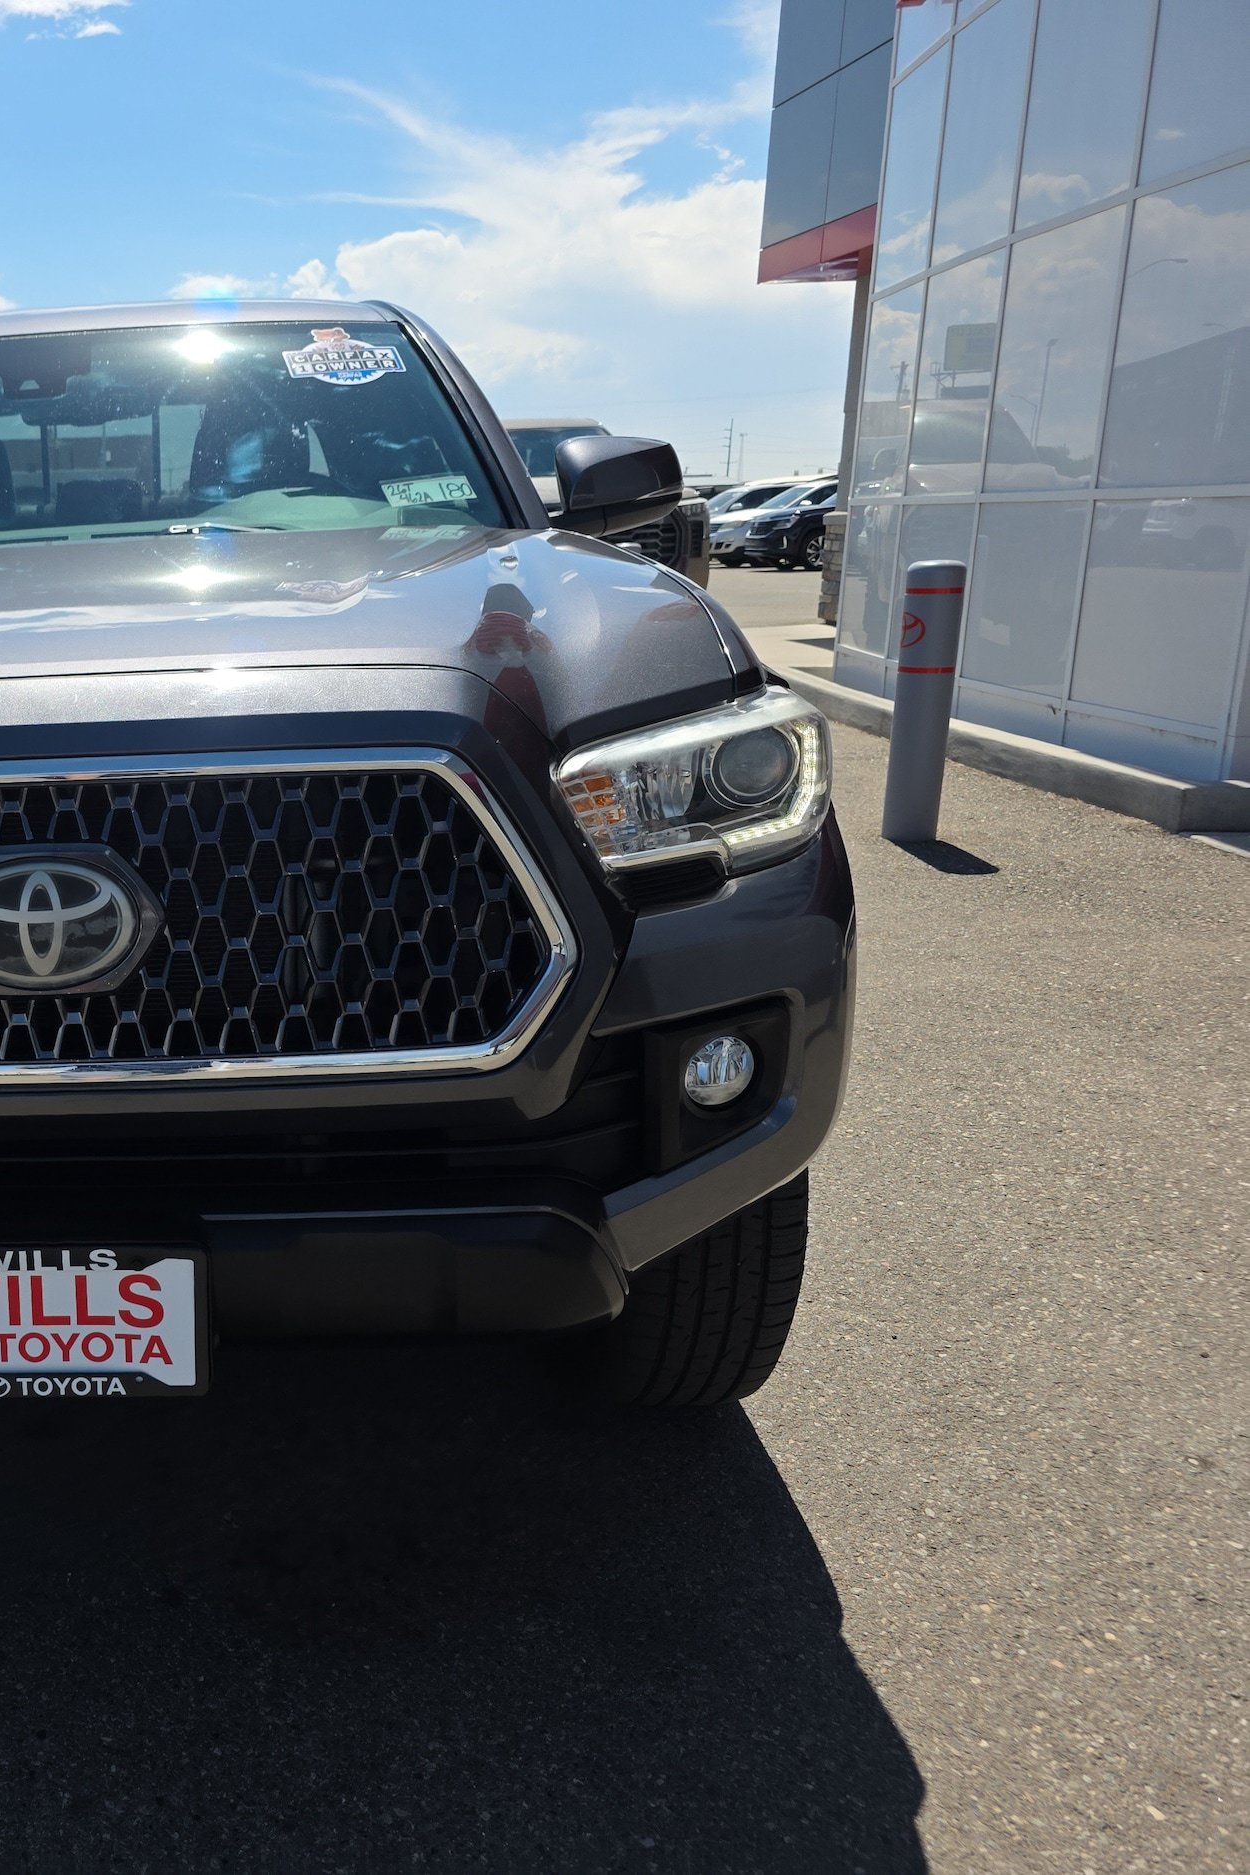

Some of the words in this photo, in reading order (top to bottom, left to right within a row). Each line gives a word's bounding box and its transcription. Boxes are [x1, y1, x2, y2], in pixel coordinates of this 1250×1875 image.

[293, 350, 392, 363] CARFAX
[314, 358, 395, 372] OWNER
[399, 491, 434, 504] 462A
[438, 482, 473, 500] 180
[15, 1376, 127, 1397] TOYOTA
